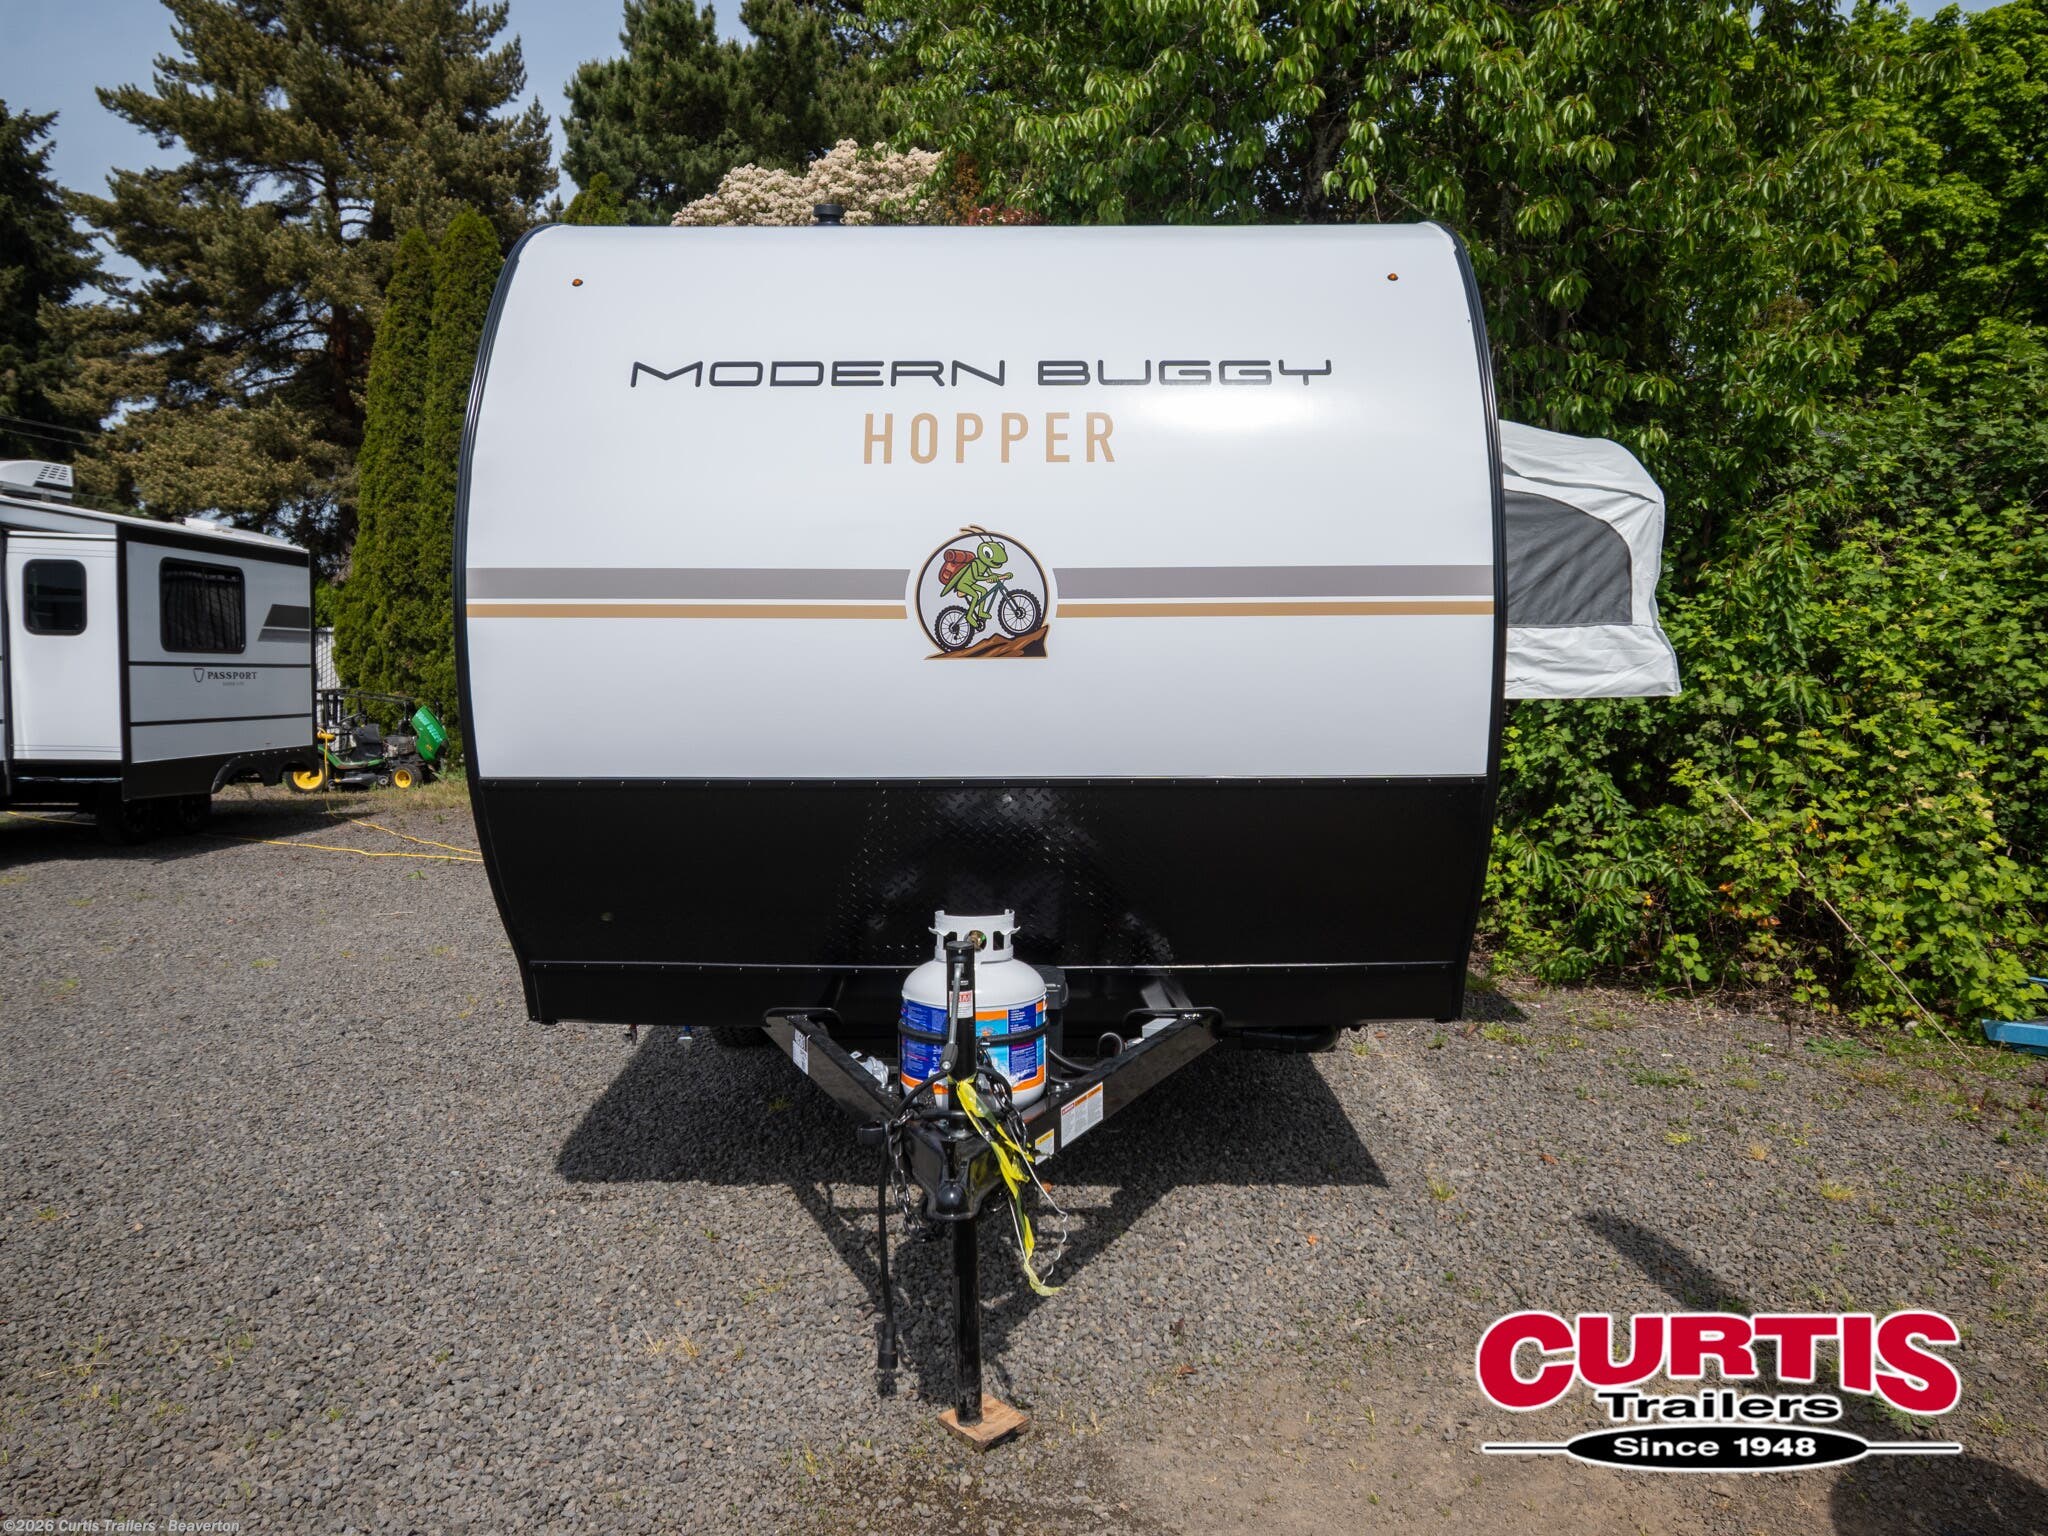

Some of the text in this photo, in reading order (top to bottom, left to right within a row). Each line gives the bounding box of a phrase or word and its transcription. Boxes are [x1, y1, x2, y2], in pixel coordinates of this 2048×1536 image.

[630, 359, 1332, 388] MODERN BUGGY
[863, 411, 1116, 465] HOPPER
[207, 671, 257, 680] PASSPORT
